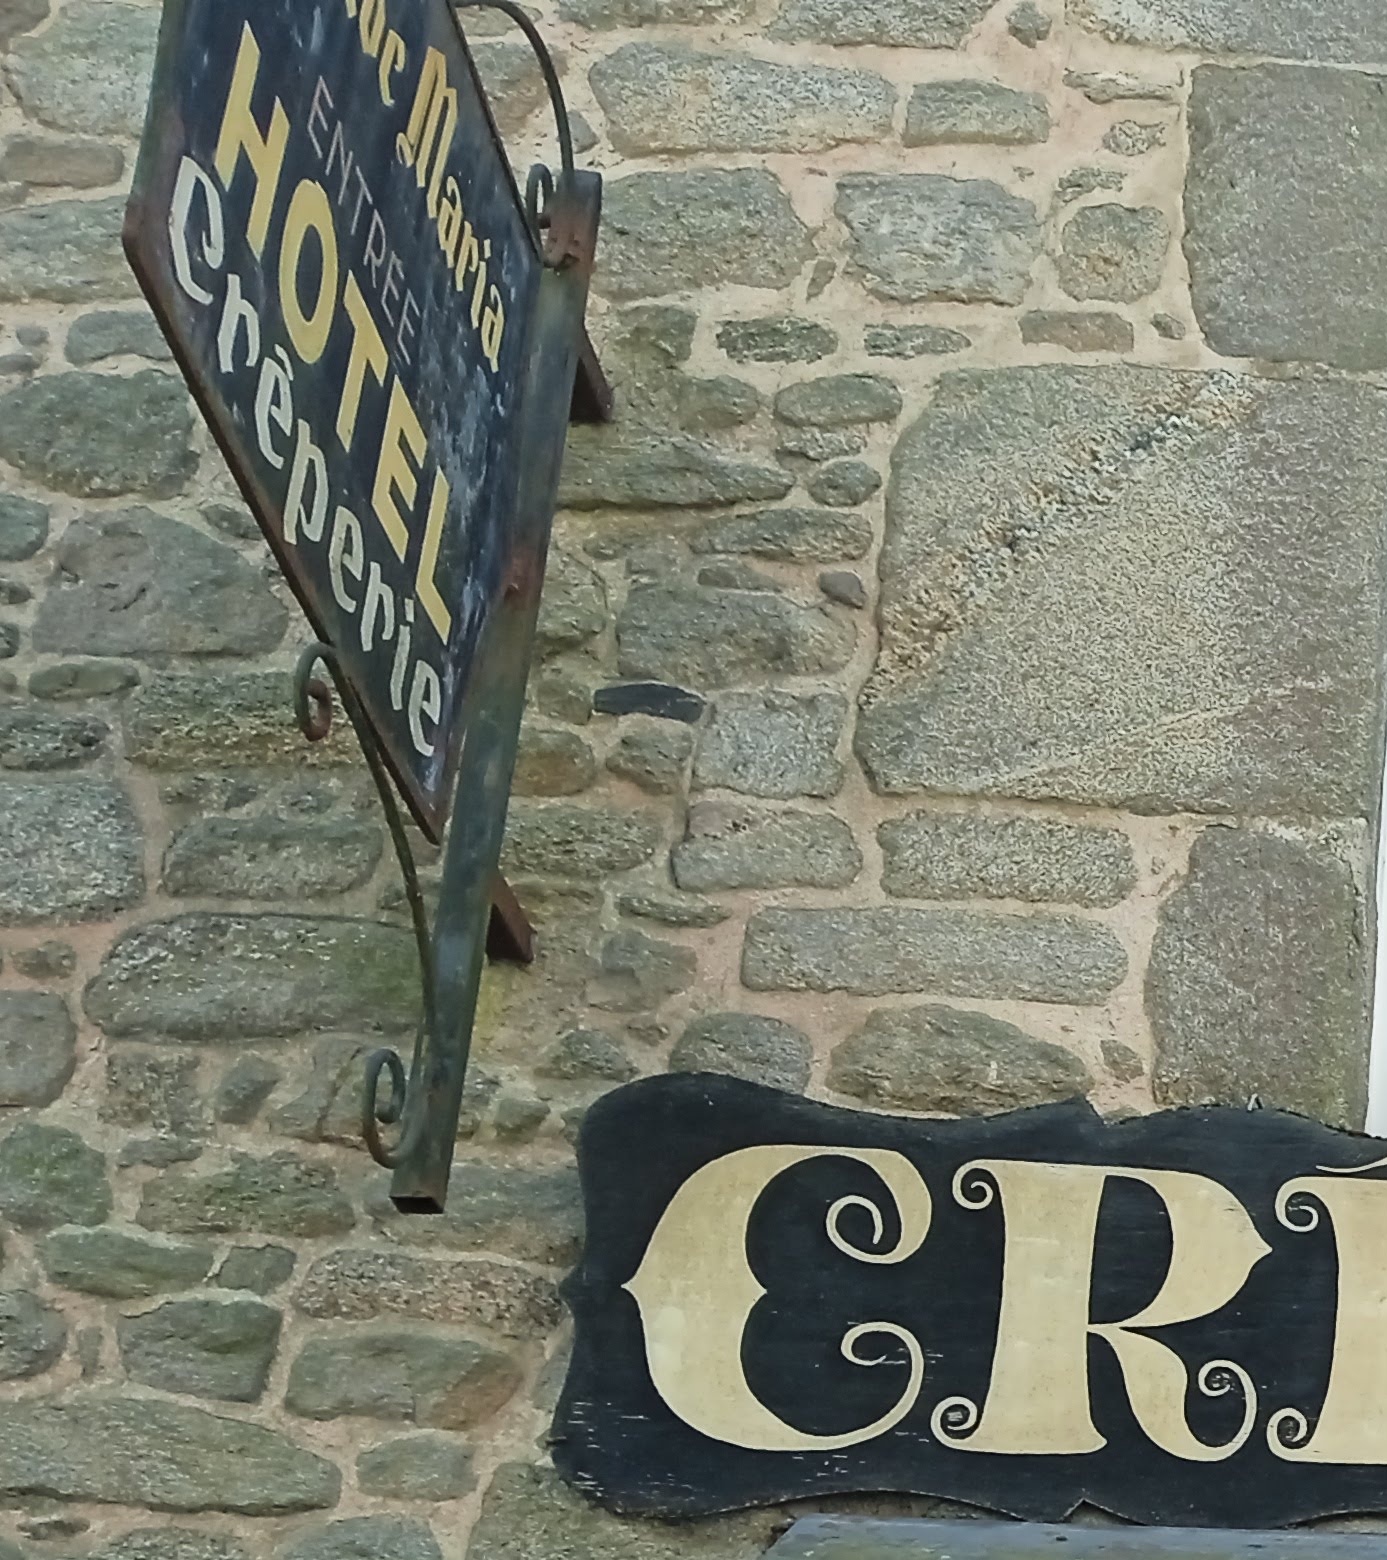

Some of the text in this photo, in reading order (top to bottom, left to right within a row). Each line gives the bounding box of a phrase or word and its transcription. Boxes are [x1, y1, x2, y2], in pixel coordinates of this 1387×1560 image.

[214, 19, 452, 646] HOTEL
[306, 75, 421, 366] ENTREE
[346, 0, 505, 374] oc Maria
